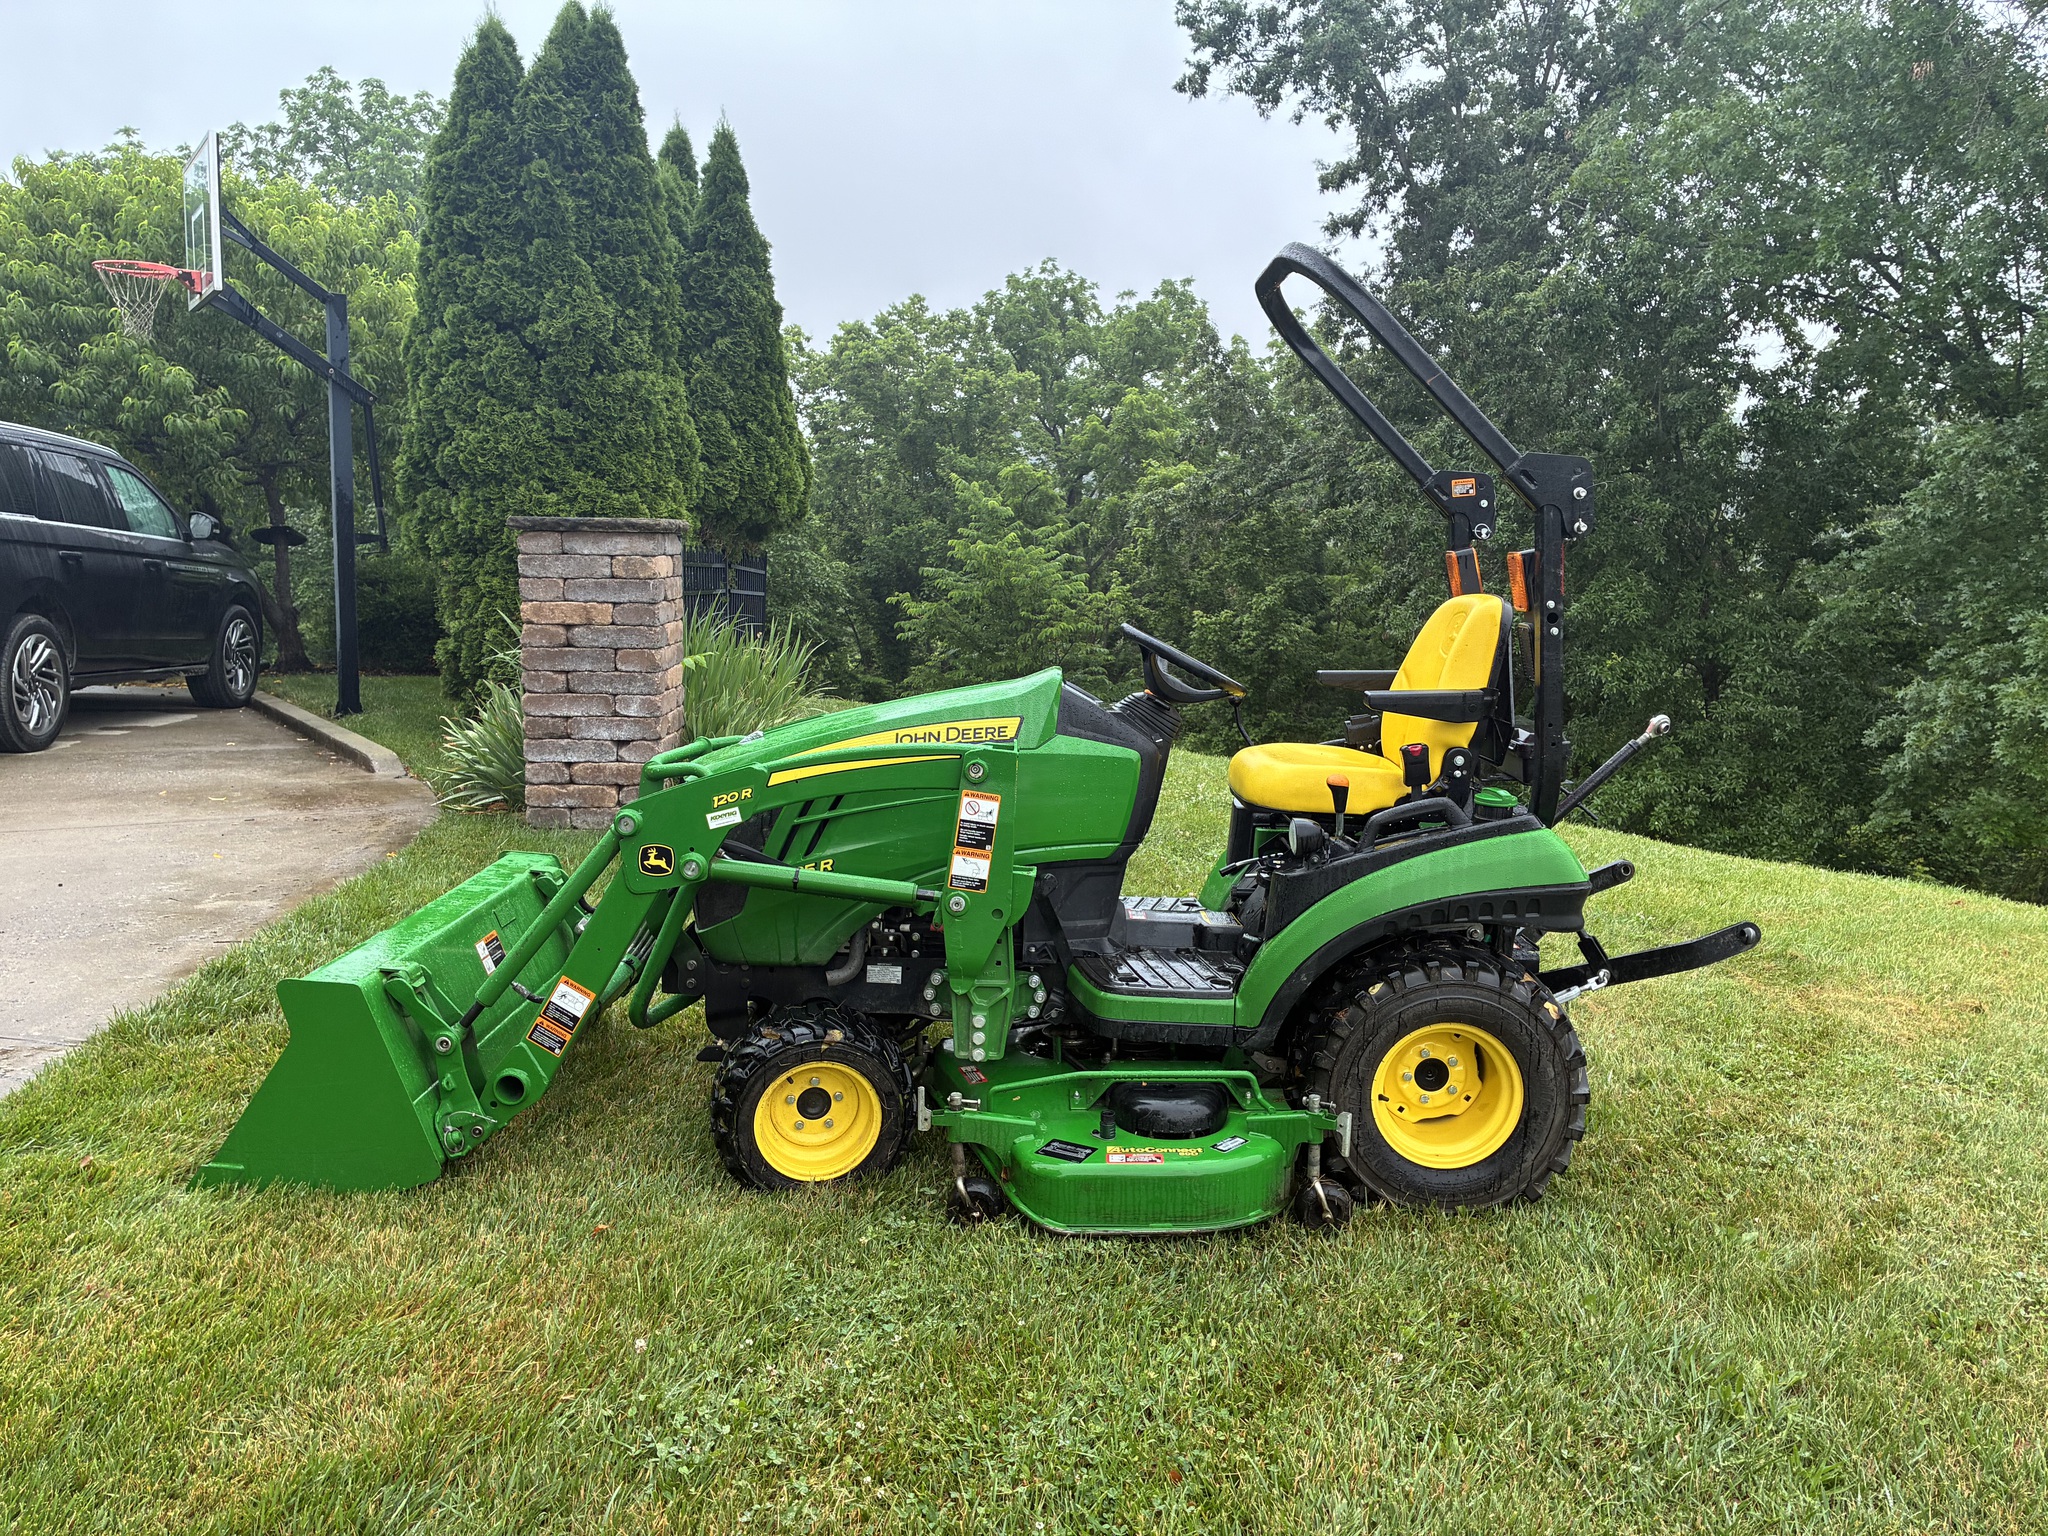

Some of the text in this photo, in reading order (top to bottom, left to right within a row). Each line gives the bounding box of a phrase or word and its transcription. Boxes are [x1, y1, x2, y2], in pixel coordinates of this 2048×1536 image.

[895, 725, 1008, 744] JOHN DEERE
[712, 791, 740, 809] 120
[969, 793, 999, 802] WARNING
[960, 850, 990, 860] WARNING
[569, 982, 591, 998] WARNING
[546, 1024, 568, 1039] WARNING
[1107, 1146, 1203, 1154] AutoConnect
